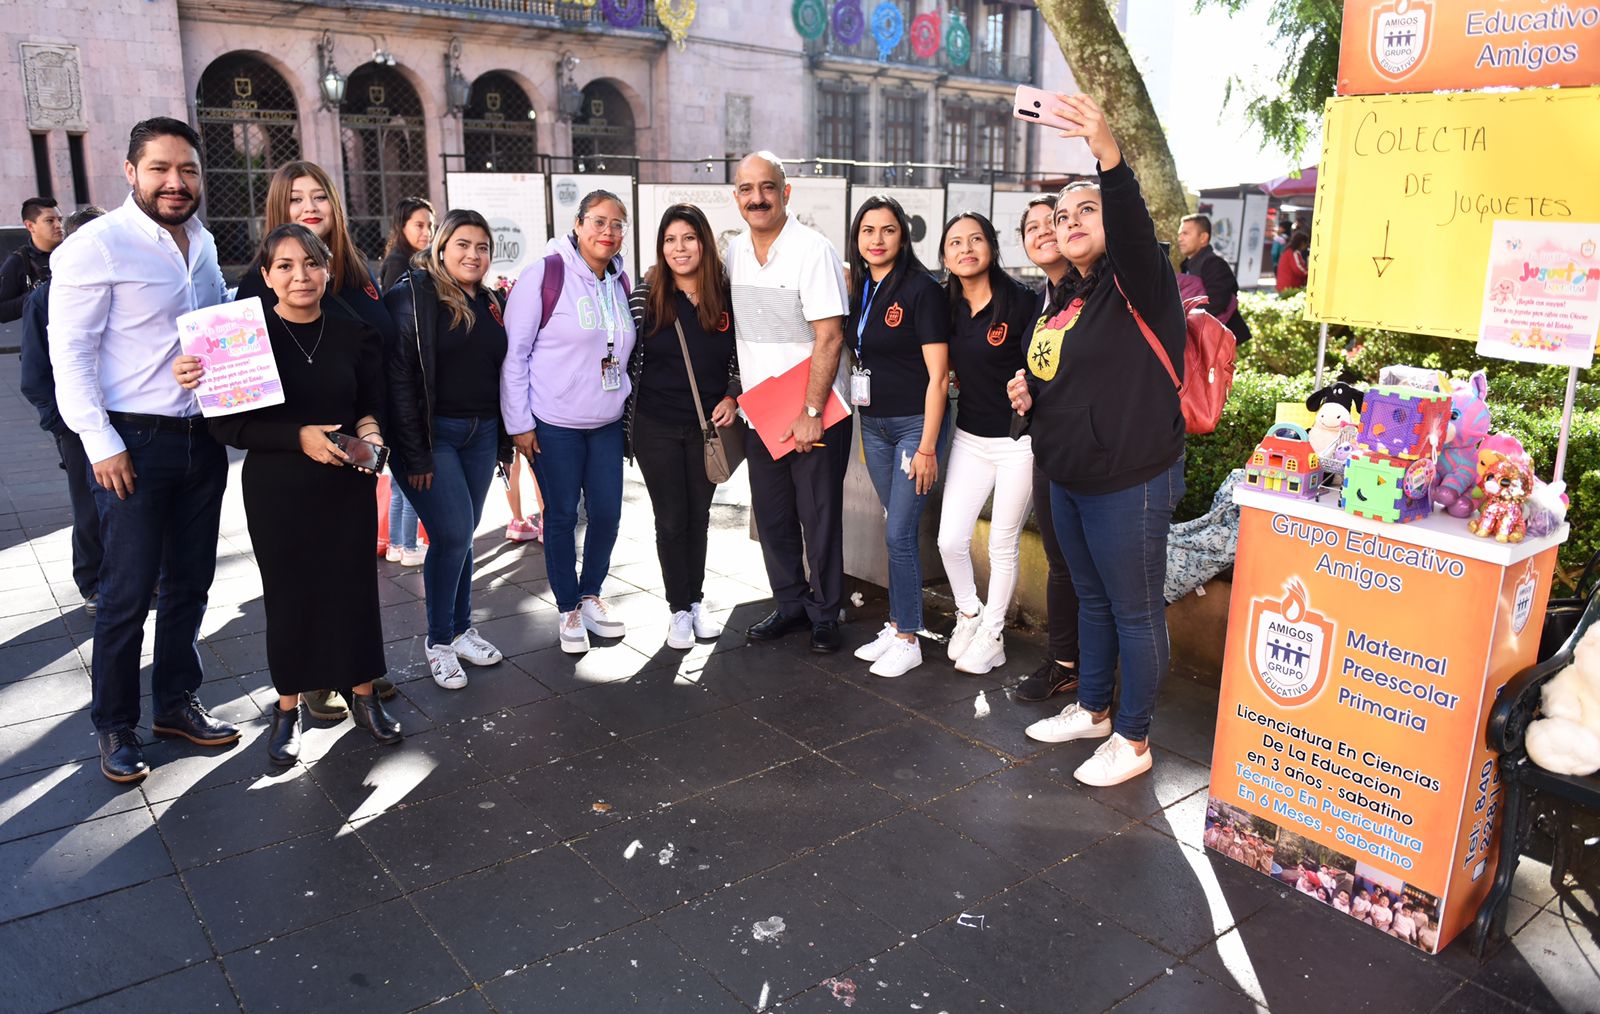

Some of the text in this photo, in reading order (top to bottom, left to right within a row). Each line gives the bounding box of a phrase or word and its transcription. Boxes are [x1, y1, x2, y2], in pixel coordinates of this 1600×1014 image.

[1385, 16, 1418, 27] AMIGOS
[1466, 6, 1599, 37] Educativo
[1380, 56, 1416, 72] EDUCATIVO
[1385, 48, 1412, 57] GRUPO
[1476, 41, 1578, 70] Amigos
[1354, 111, 1487, 157] COLECTA
[1404, 172, 1433, 198] DE
[1436, 190, 1572, 226] JUGUETES
[1272, 513, 1465, 578] Grupo Educativo
[1315, 553, 1402, 593] Amigos
[1268, 621, 1314, 643] AMIGOS
[1267, 662, 1304, 680] GRUPO
[1346, 630, 1447, 676] Maternal
[1260, 671, 1309, 698] EDUCATIVO
[1342, 657, 1459, 710] Preescolar
[1338, 687, 1427, 732] Primaria
[1237, 703, 1441, 792] Licenciatura En Ciencias
[1262, 733, 1401, 800] De La Educacion
[1235, 763, 1423, 853] Técnico En Puericultura
[1247, 750, 1266, 767] en
[1271, 757, 1281, 772] 3
[1284, 764, 1323, 791] años
[1338, 786, 1414, 827] sabatino
[1238, 784, 1256, 803] En
[1260, 794, 1270, 809] 6
[1273, 799, 1322, 832] Meses
[1336, 829, 1413, 870] Sabatino
